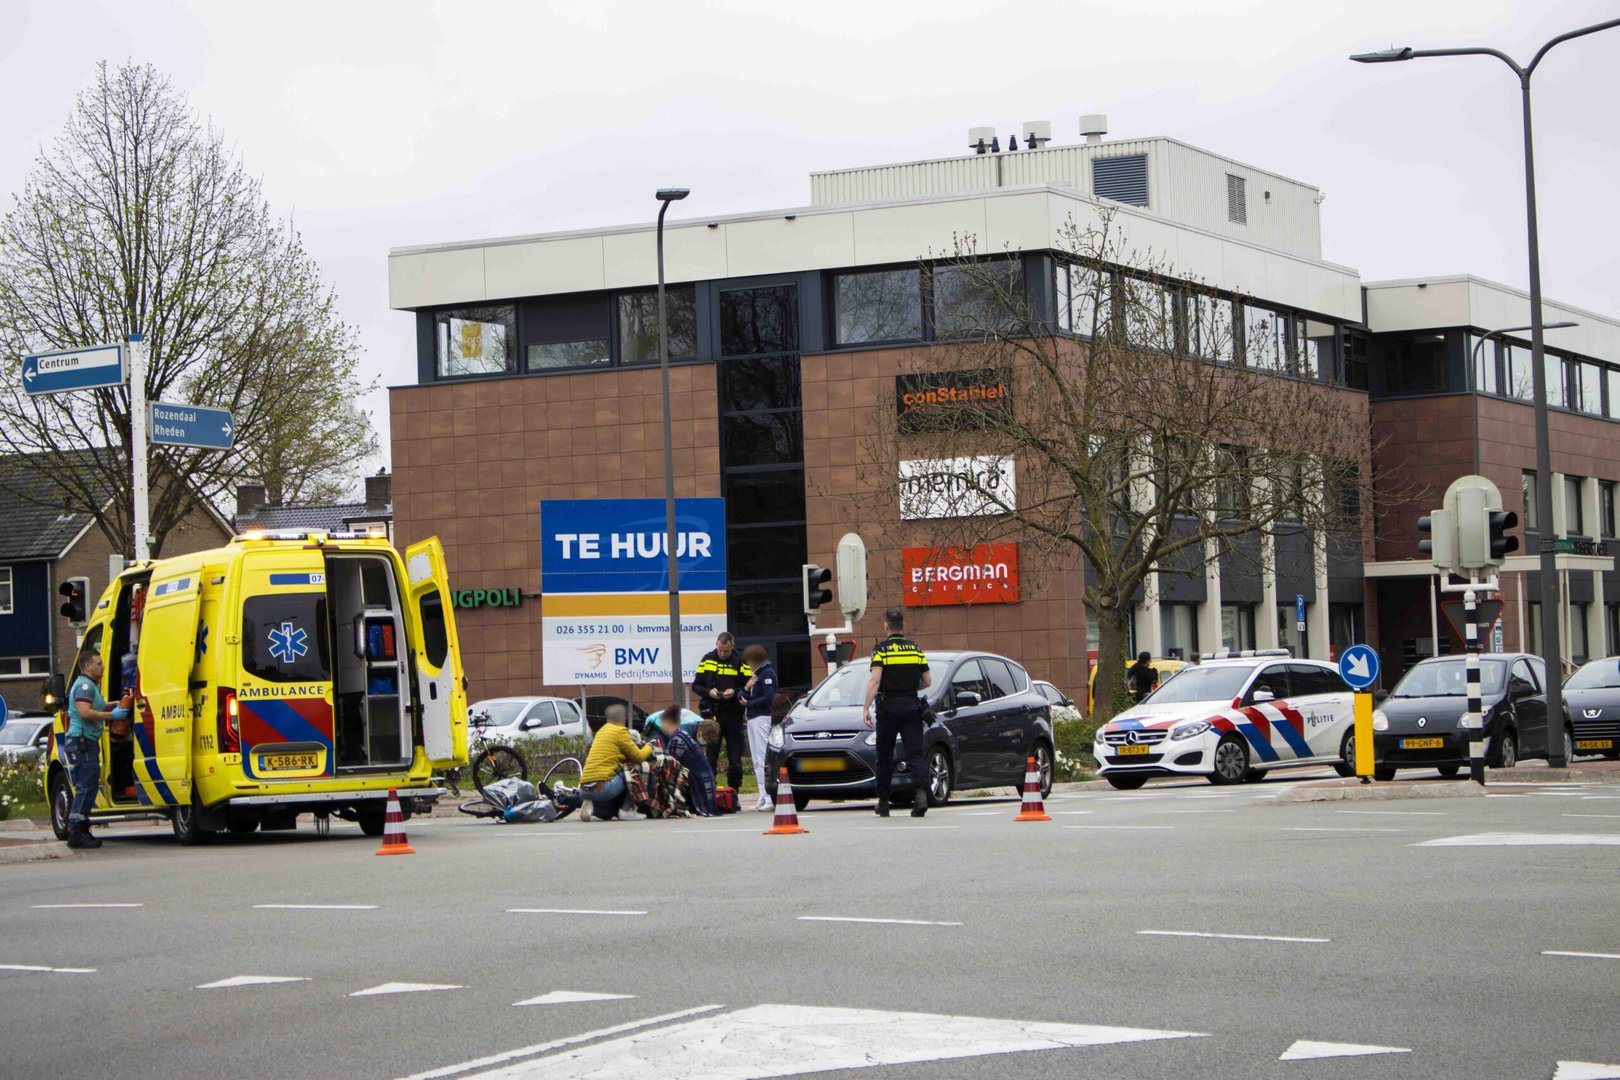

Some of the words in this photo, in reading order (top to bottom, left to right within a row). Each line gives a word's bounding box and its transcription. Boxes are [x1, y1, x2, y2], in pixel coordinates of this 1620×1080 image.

[39, 357, 79, 369] Centrum
[154, 408, 197, 422] Rozendaal
[154, 424, 185, 437] Rheden
[555, 533, 600, 559] TE
[611, 532, 712, 558] HUUR
[912, 563, 1008, 582] BERGMAN
[556, 625, 574, 634] 026
[578, 625, 595, 634] 355
[599, 625, 609, 634] 21
[612, 624, 624, 633] 00
[637, 623, 713, 633] bmvmalaars.nl
[615, 648, 660, 665] BMV
[615, 668, 696, 680] Bedrijfsmakears
[239, 685, 324, 698] AMBULANCE
[267, 756, 314, 767] K-586-RK
